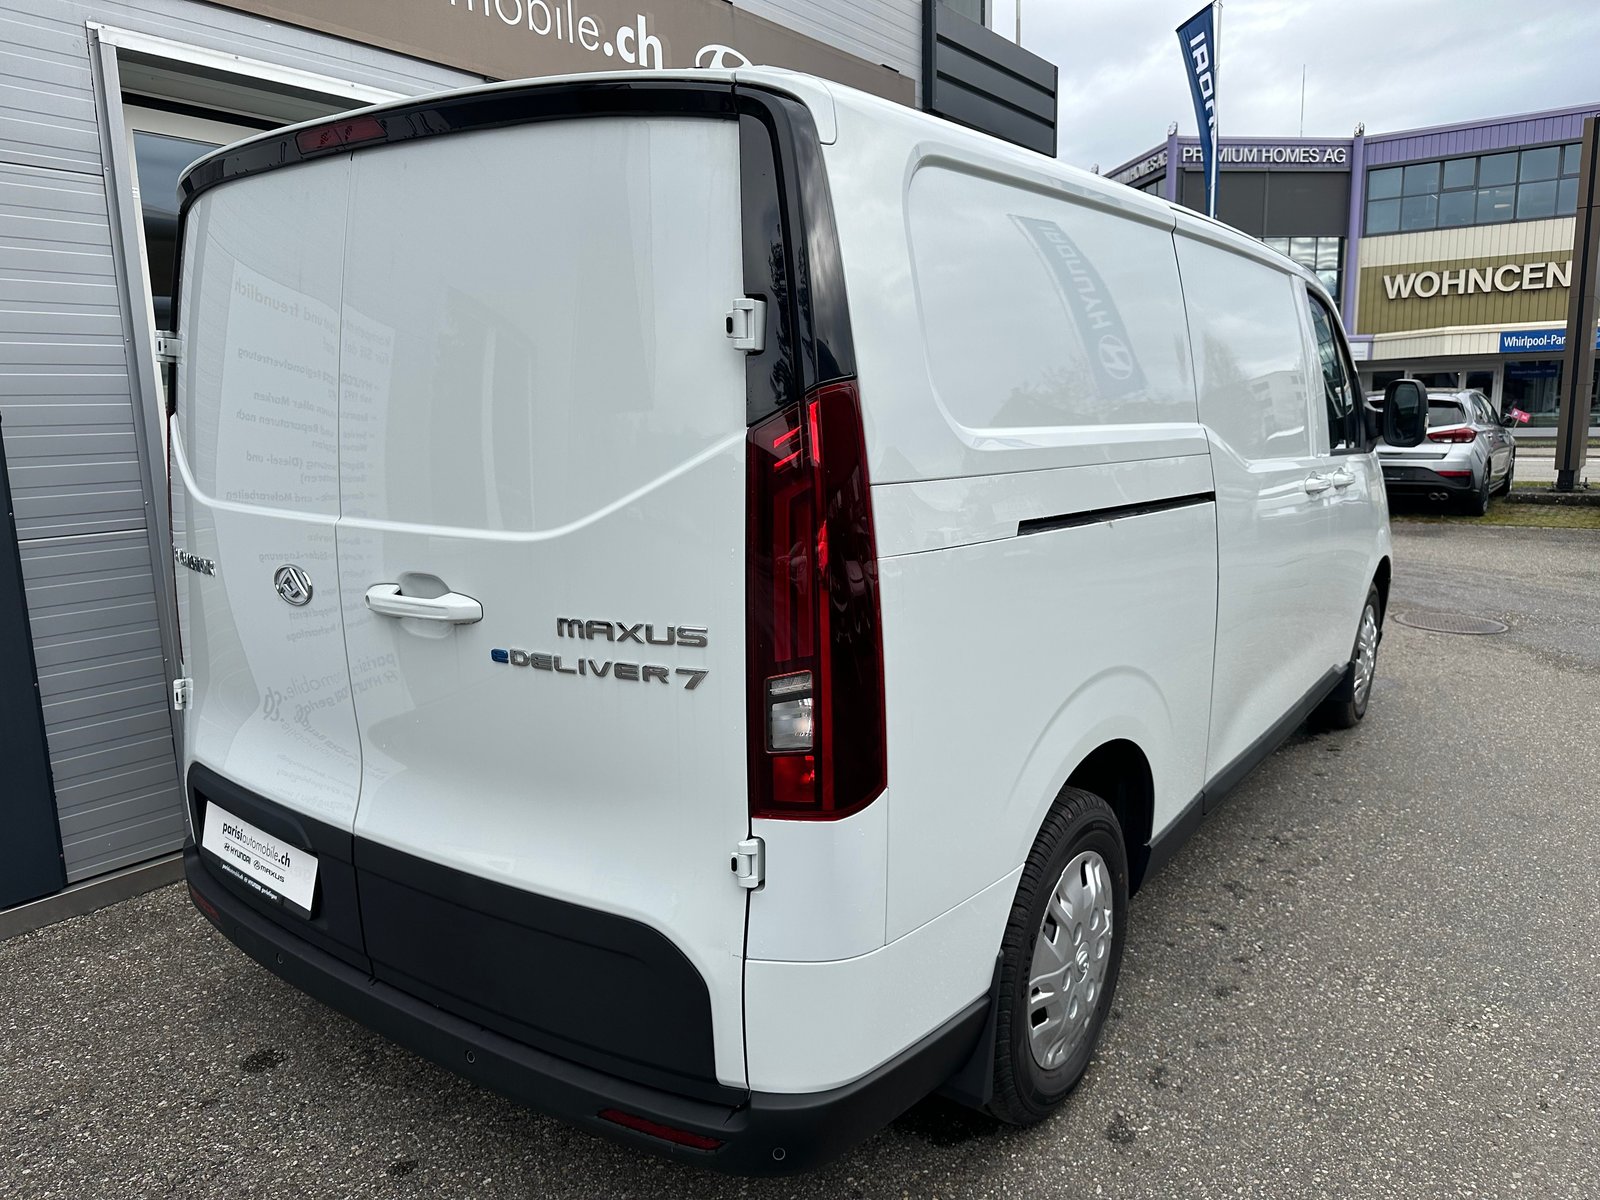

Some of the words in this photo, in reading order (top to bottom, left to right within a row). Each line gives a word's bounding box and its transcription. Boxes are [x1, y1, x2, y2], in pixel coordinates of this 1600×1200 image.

[449, 0, 663, 70] obile.ch
[1182, 147, 1257, 163] PRMIUM
[1262, 147, 1319, 163] HOMES
[1323, 148, 1346, 163] AG
[1383, 260, 1573, 301] WOHNCEN
[556, 617, 709, 648] MAXUS
[675, 666, 709, 690] 7
[222, 822, 291, 868] parisiautomobile.ch
[230, 847, 252, 865] HYUNDAI
[260, 864, 285, 883] MAXUS
